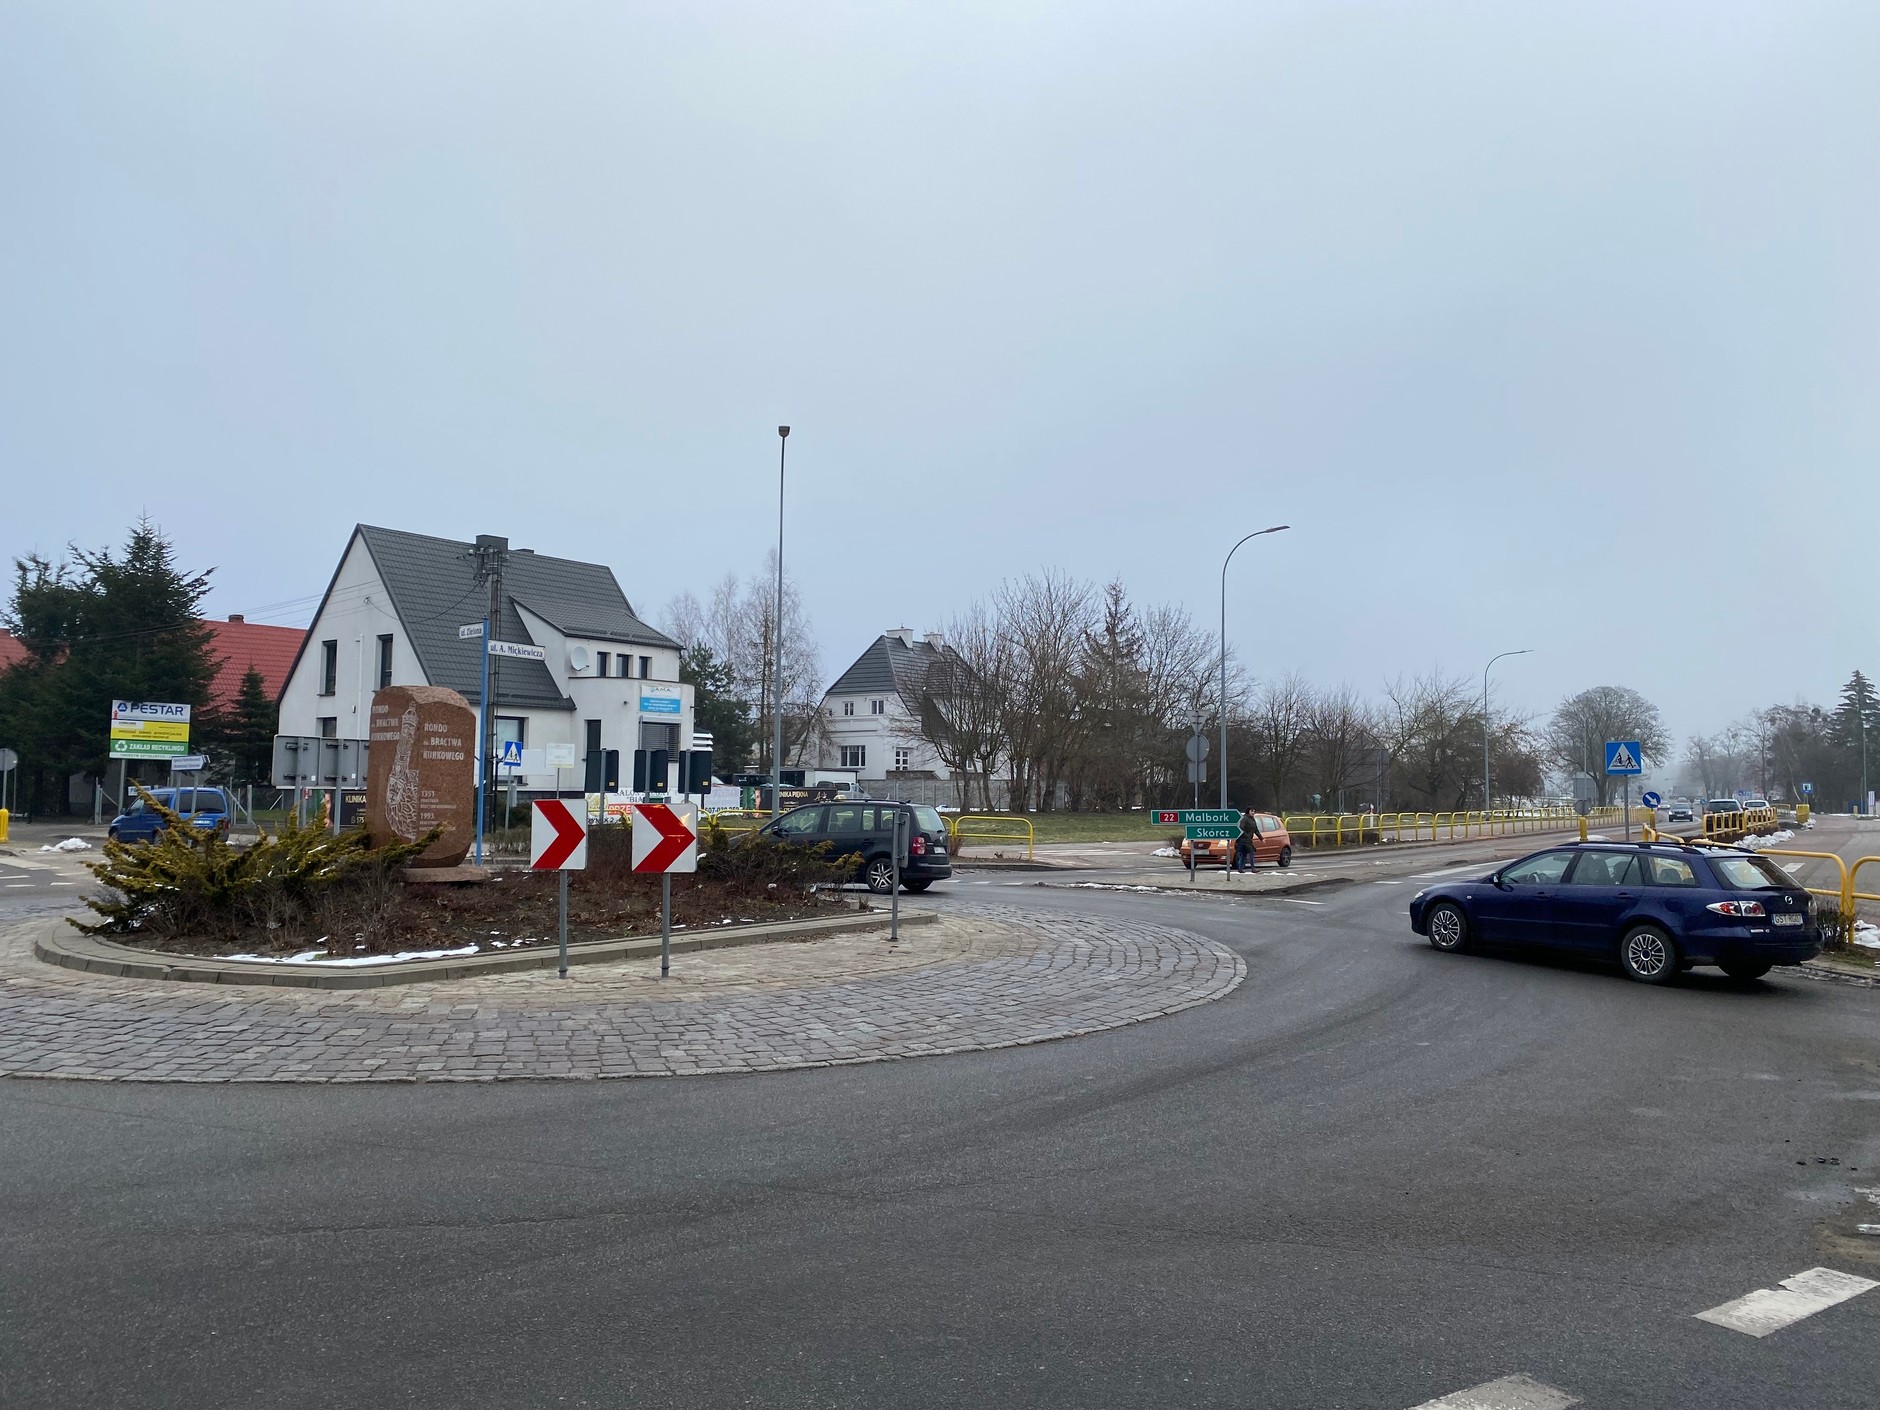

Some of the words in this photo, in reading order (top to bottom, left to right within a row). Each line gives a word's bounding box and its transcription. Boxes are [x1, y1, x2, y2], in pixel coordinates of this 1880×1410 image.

[467, 627, 482, 636] Zielona
[499, 644, 506, 652] A.
[130, 703, 184, 716] PESTAR
[424, 723, 447, 732] RONDO
[430, 737, 461, 746] BRACTWA
[423, 751, 464, 760] KURKOWEGO
[1186, 813, 1229, 822] Malbork
[1197, 828, 1229, 837] Skórcz
